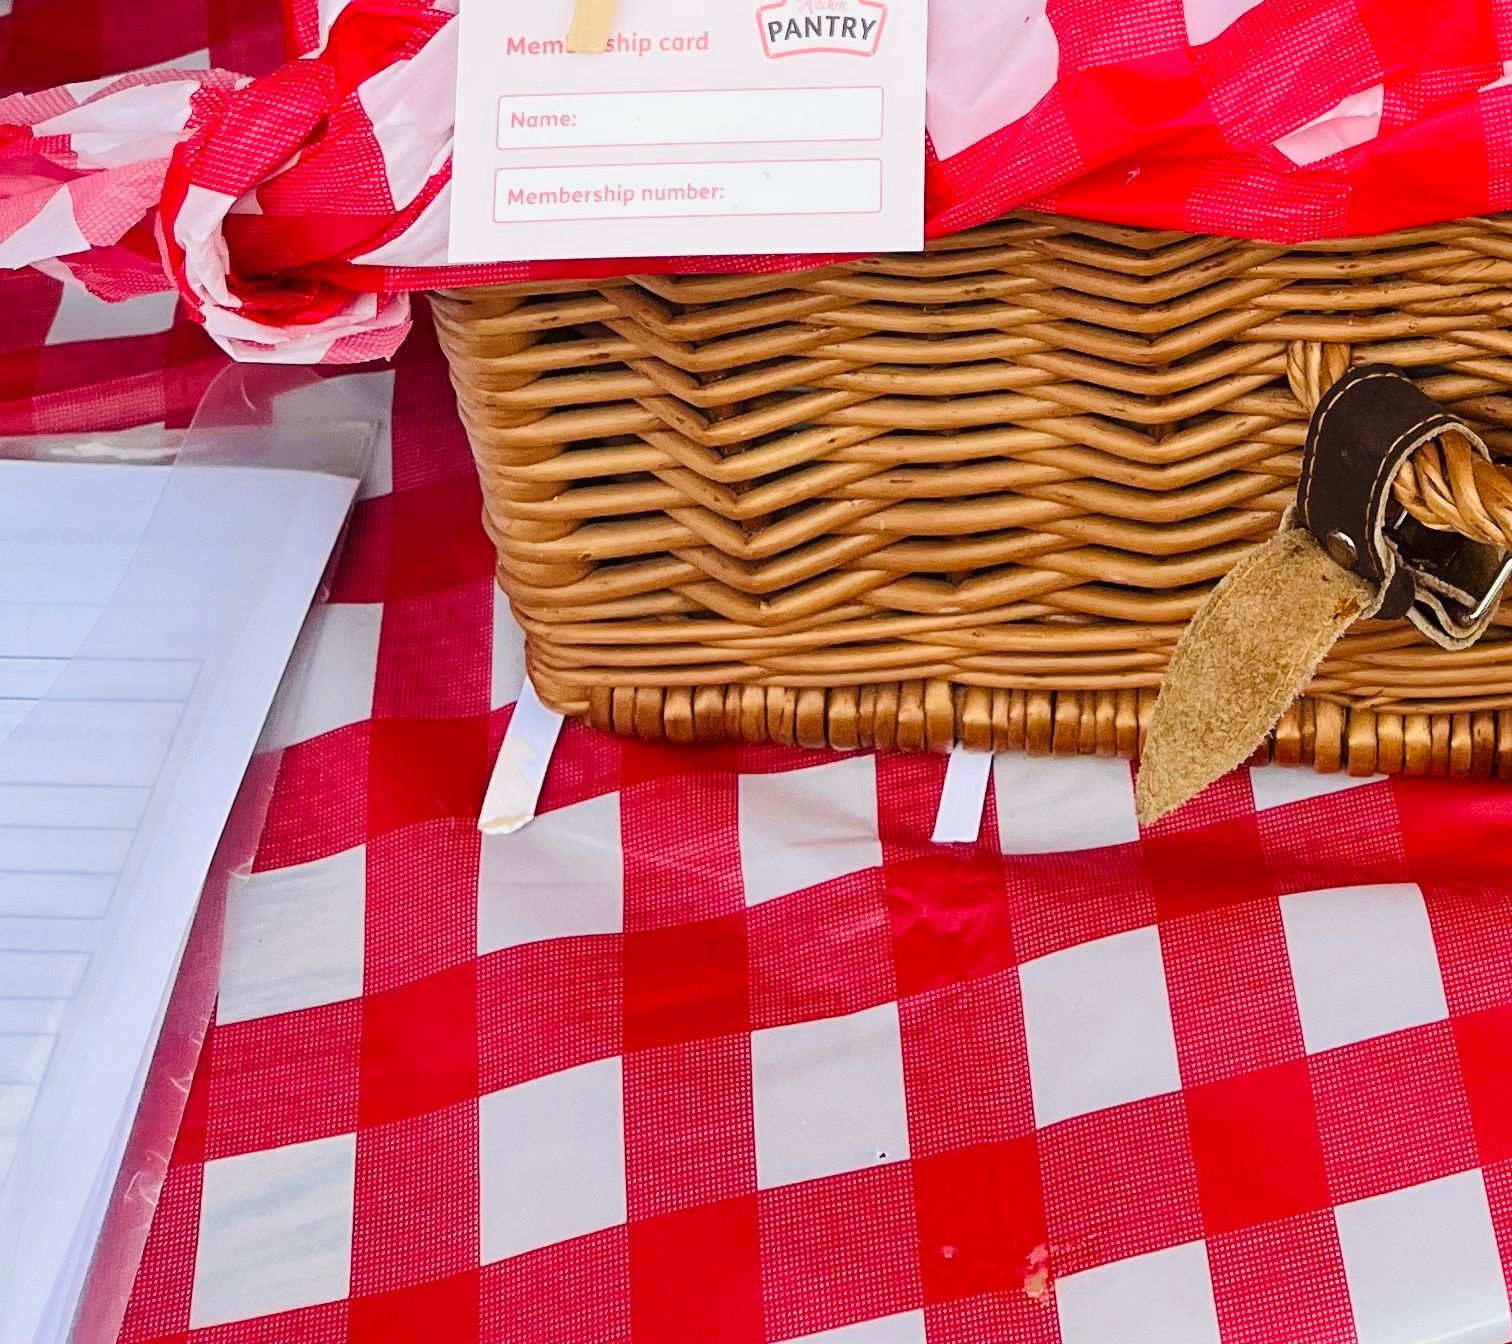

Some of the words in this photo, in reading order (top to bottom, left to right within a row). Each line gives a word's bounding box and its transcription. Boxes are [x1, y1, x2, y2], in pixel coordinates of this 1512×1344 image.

[767, 15, 877, 44] PANTRY
[506, 31, 653, 57] Memship
[659, 30, 710, 52] card
[511, 110, 577, 130] Name:
[507, 184, 635, 207] Membership
[641, 182, 725, 202] number:
